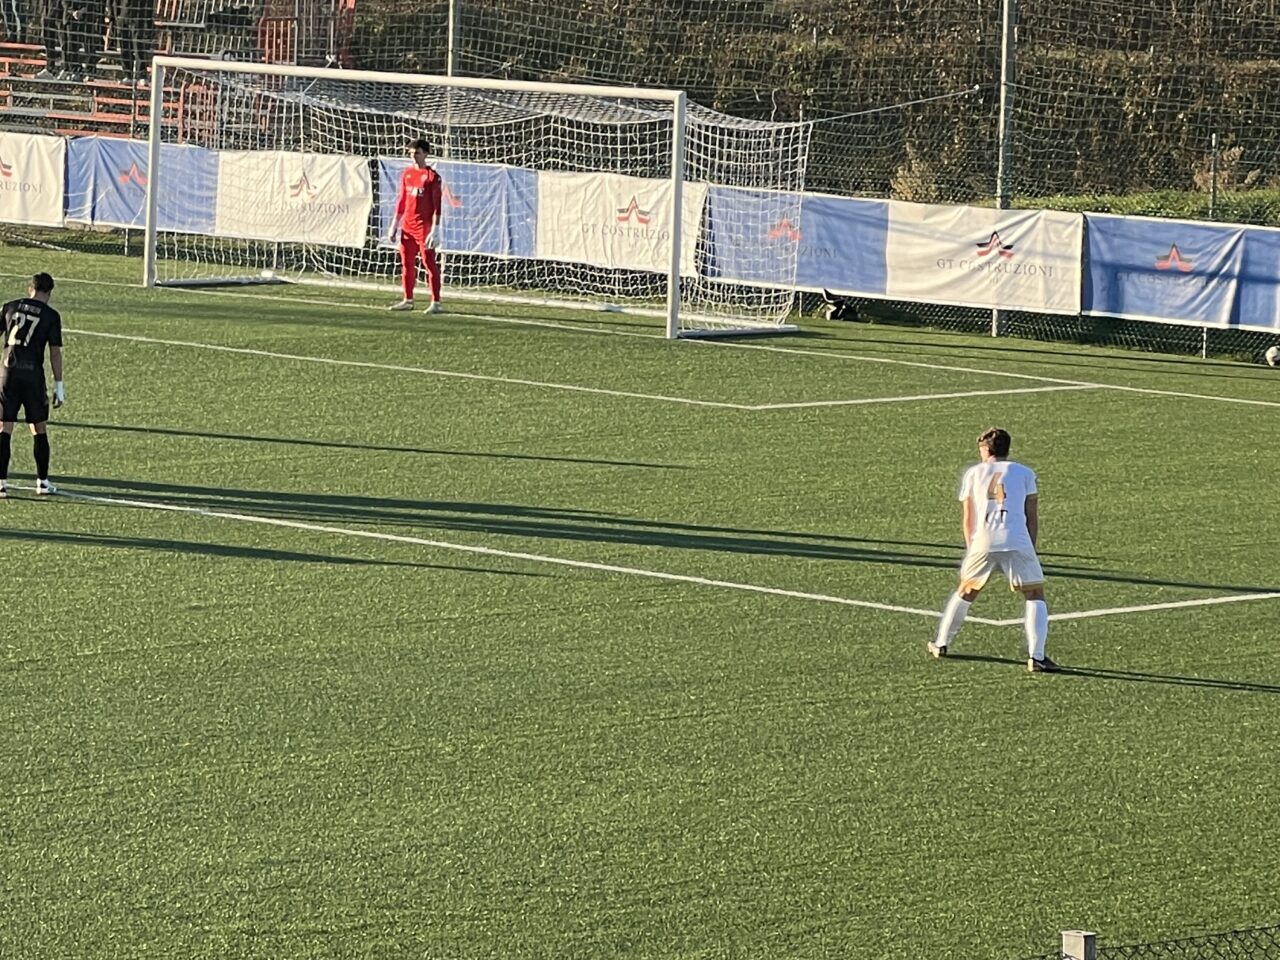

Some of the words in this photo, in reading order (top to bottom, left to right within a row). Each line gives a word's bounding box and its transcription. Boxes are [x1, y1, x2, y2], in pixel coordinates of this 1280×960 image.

[936, 259, 955, 270] GT
[959, 259, 1053, 277] COSTRUZIONI
[7, 311, 41, 347] 27
[986, 471, 1007, 505] 4
